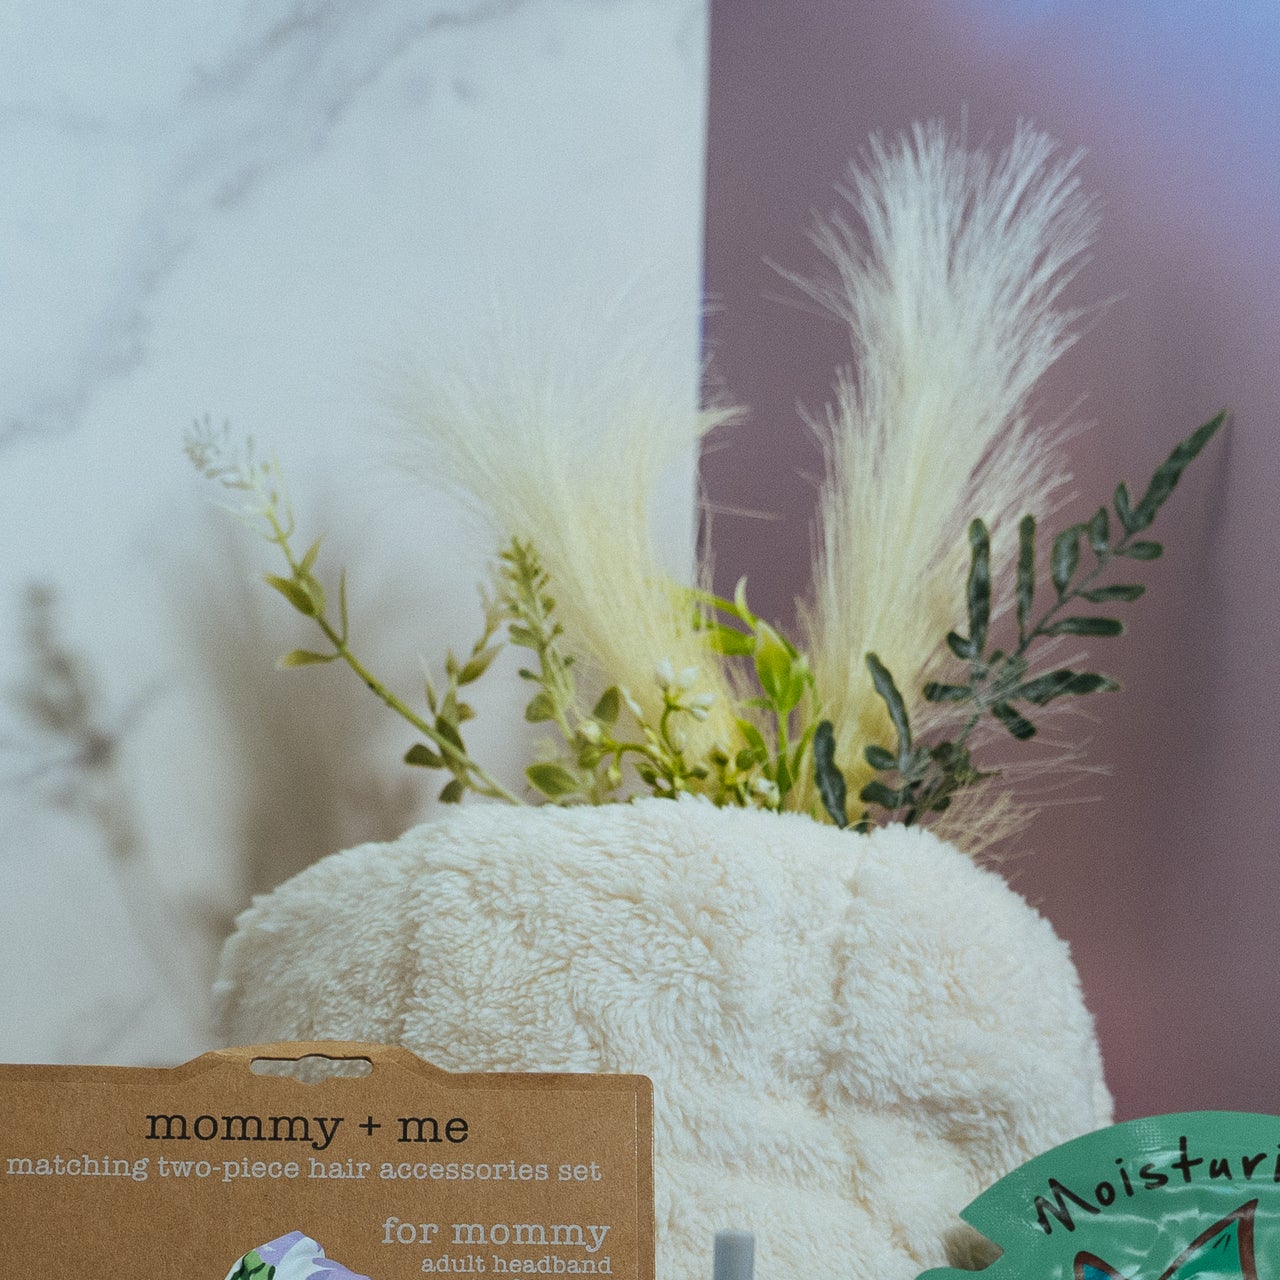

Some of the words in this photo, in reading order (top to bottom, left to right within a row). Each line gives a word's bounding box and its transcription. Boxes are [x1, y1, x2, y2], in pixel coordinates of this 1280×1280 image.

[145, 1113, 344, 1151] mommy
[397, 1116, 469, 1144] me
[6, 1154, 150, 1182] matching
[158, 1156, 300, 1183] two-piece
[308, 1157, 371, 1181] hair
[379, 1160, 549, 1182] accessories
[557, 1161, 603, 1182] set
[381, 1216, 439, 1245] for
[451, 1222, 612, 1253] mommy
[421, 1255, 486, 1274] adult
[492, 1255, 613, 1275] headband
